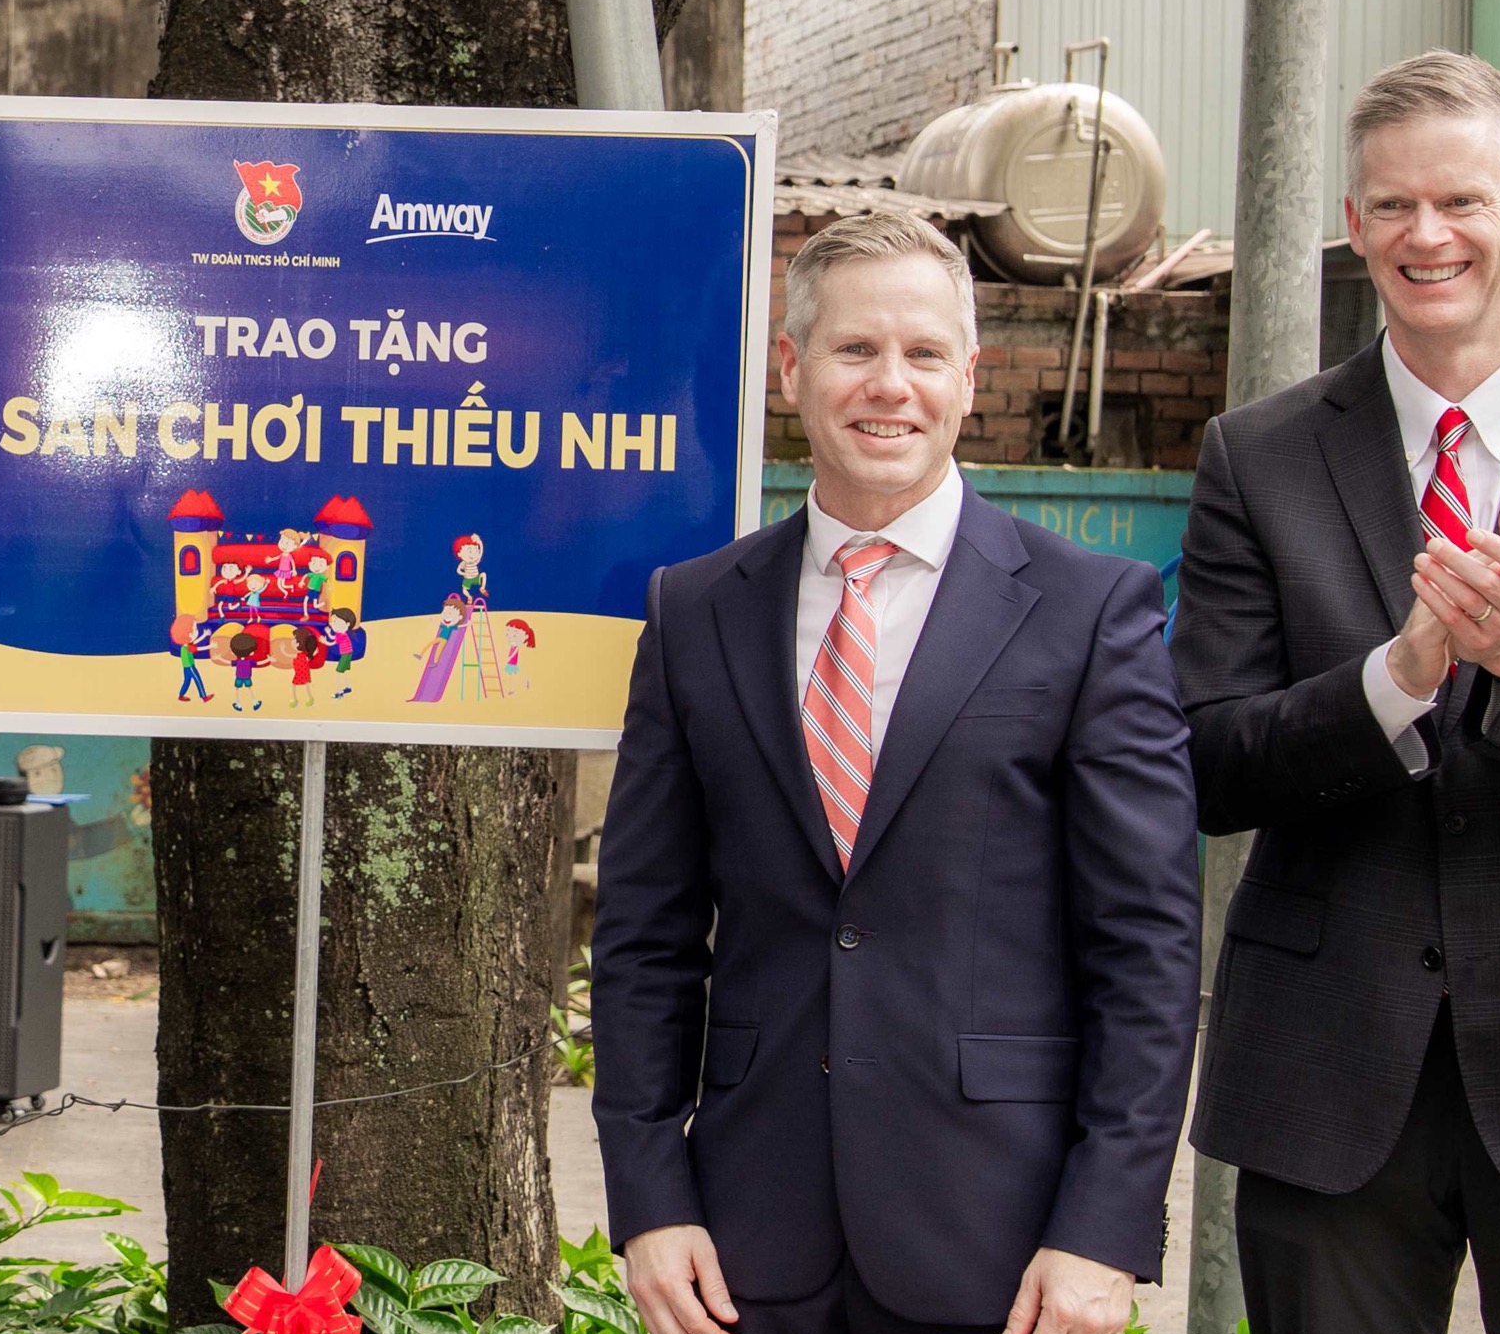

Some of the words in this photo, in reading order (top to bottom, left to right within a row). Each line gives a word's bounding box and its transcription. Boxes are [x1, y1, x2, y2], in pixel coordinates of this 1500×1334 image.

[370, 193, 493, 240] Amway
[192, 253, 209, 265] TW
[211, 251, 243, 266] ĐOÀN
[244, 254, 272, 266] TNCS
[273, 250, 290, 267] HỒ
[291, 253, 311, 267] CHÍ
[312, 256, 340, 267] MINH
[195, 315, 336, 362] TRAO
[348, 308, 489, 376] TẶNG
[158, 394, 321, 464] CHƠI
[340, 381, 540, 469] THIẾU
[561, 412, 677, 472] NHI
